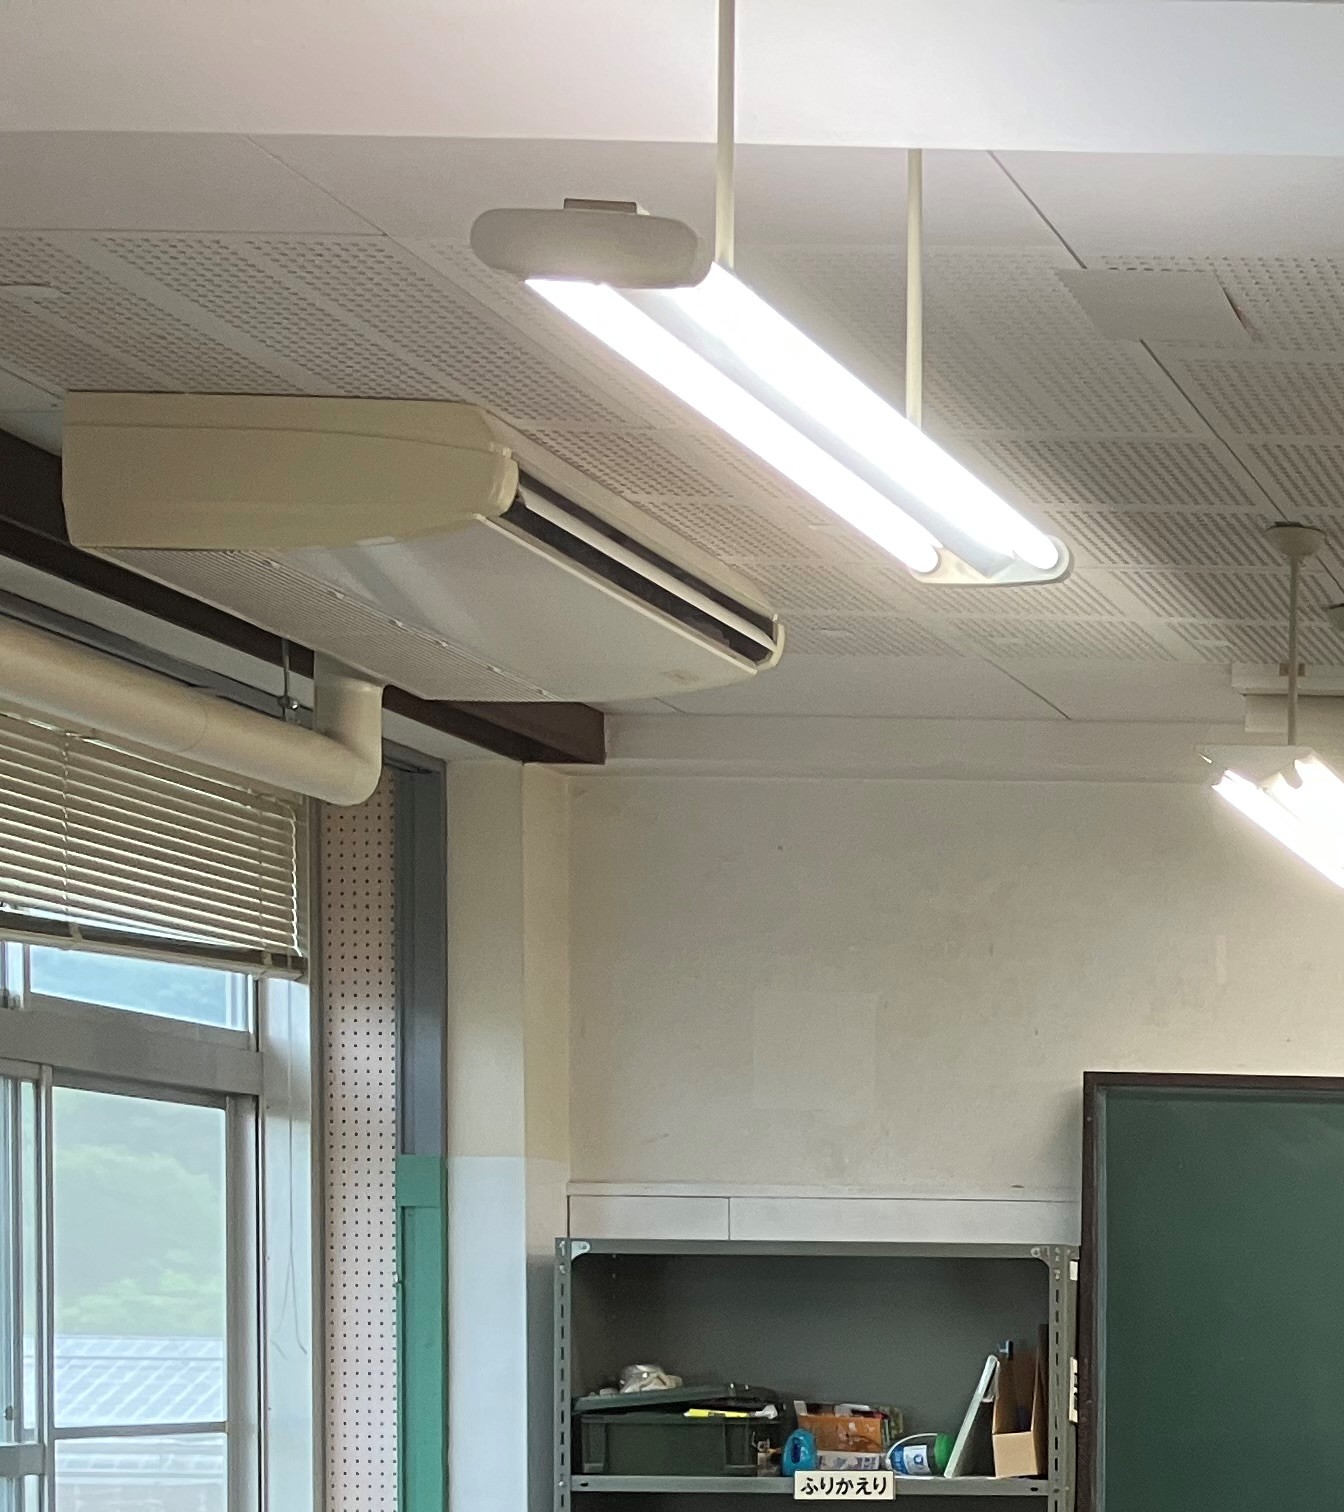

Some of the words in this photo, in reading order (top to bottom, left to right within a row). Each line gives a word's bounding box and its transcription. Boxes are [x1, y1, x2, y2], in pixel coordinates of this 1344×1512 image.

[800, 1476, 887, 1495] ふりかえり
